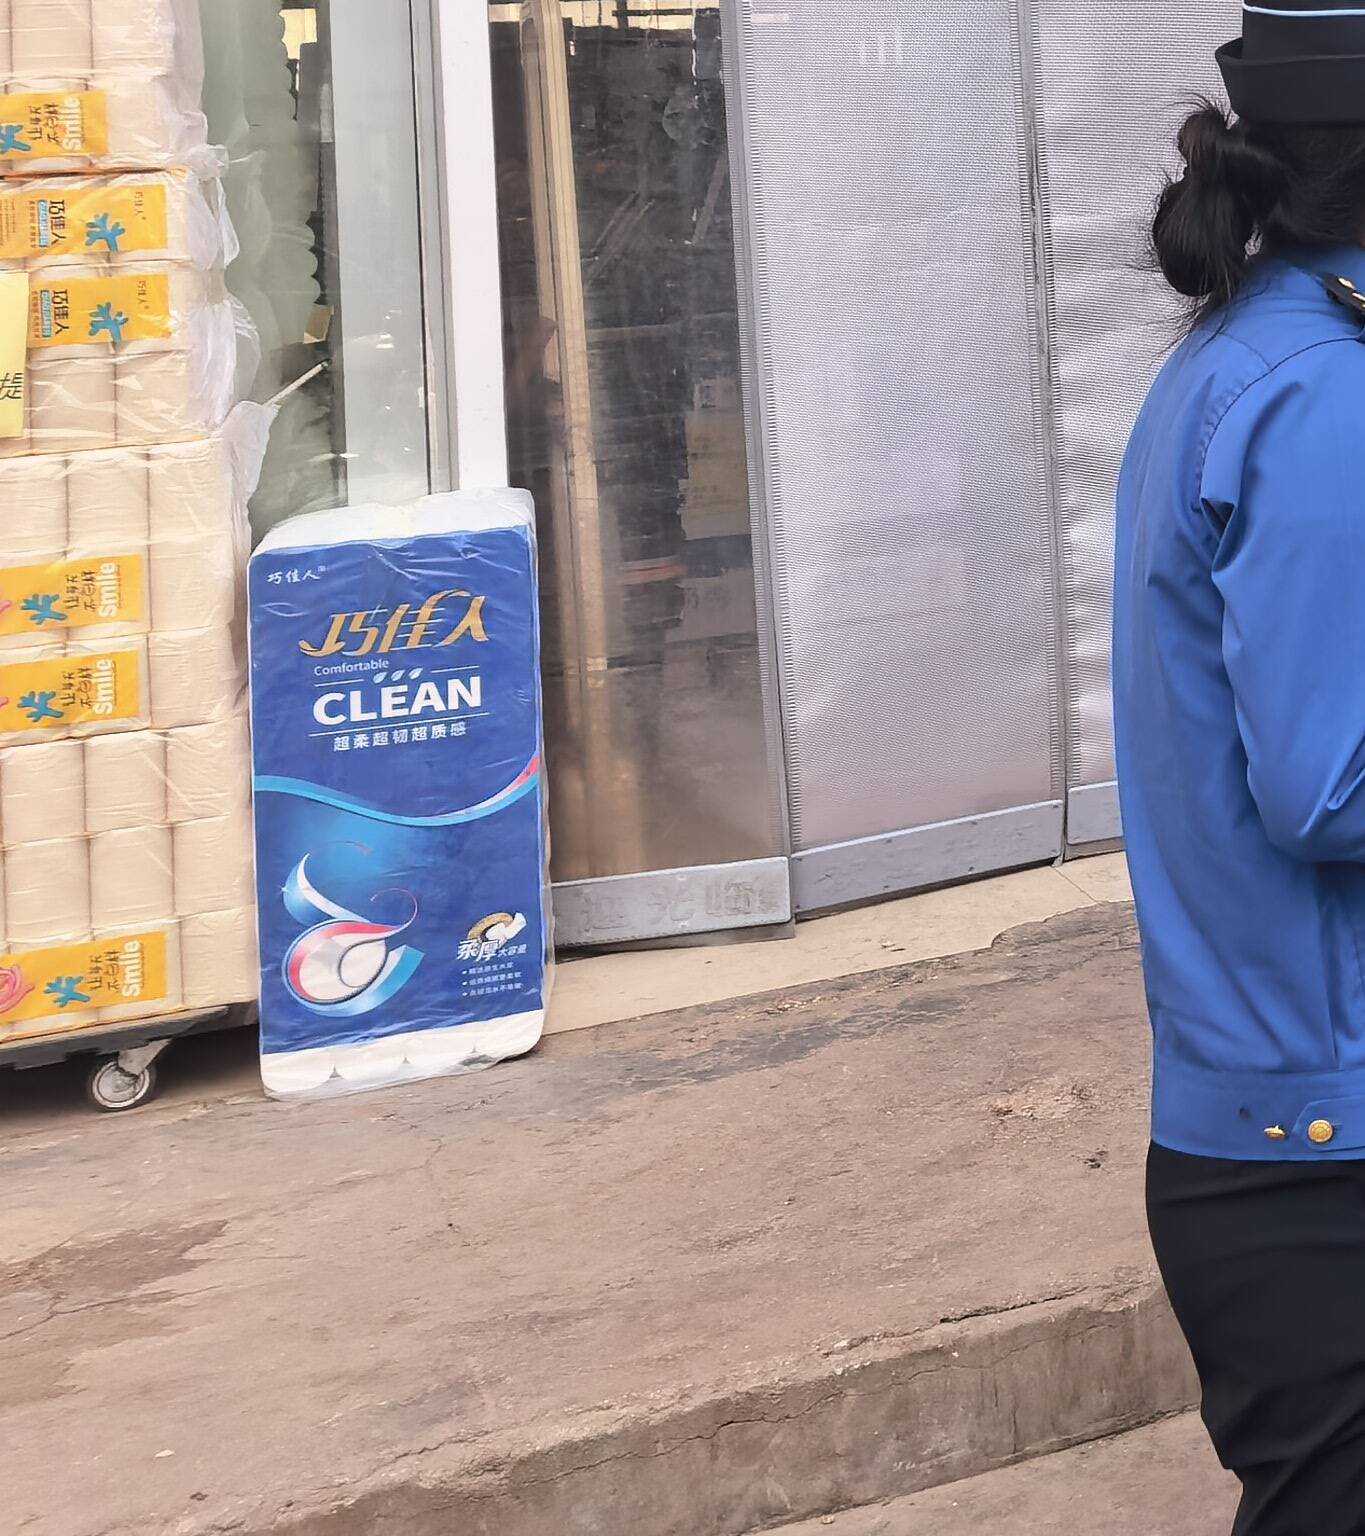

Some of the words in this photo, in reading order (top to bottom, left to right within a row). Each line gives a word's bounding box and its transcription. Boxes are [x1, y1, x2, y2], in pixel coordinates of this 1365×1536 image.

[48, 199, 67, 245] 巧佳人
[52, 289, 70, 336] 巧佳人
[99, 562, 118, 618] Smile
[266, 568, 321, 586] 巧佳人
[299, 588, 489, 657] 巧佳人
[93, 658, 113, 715] Smile
[314, 658, 390, 677] Comfortable
[312, 676, 482, 726] CLEAN
[333, 721, 467, 752] 超柔超韧超质感
[121, 940, 141, 998] Smile
[456, 939, 499, 962] 柔厚
